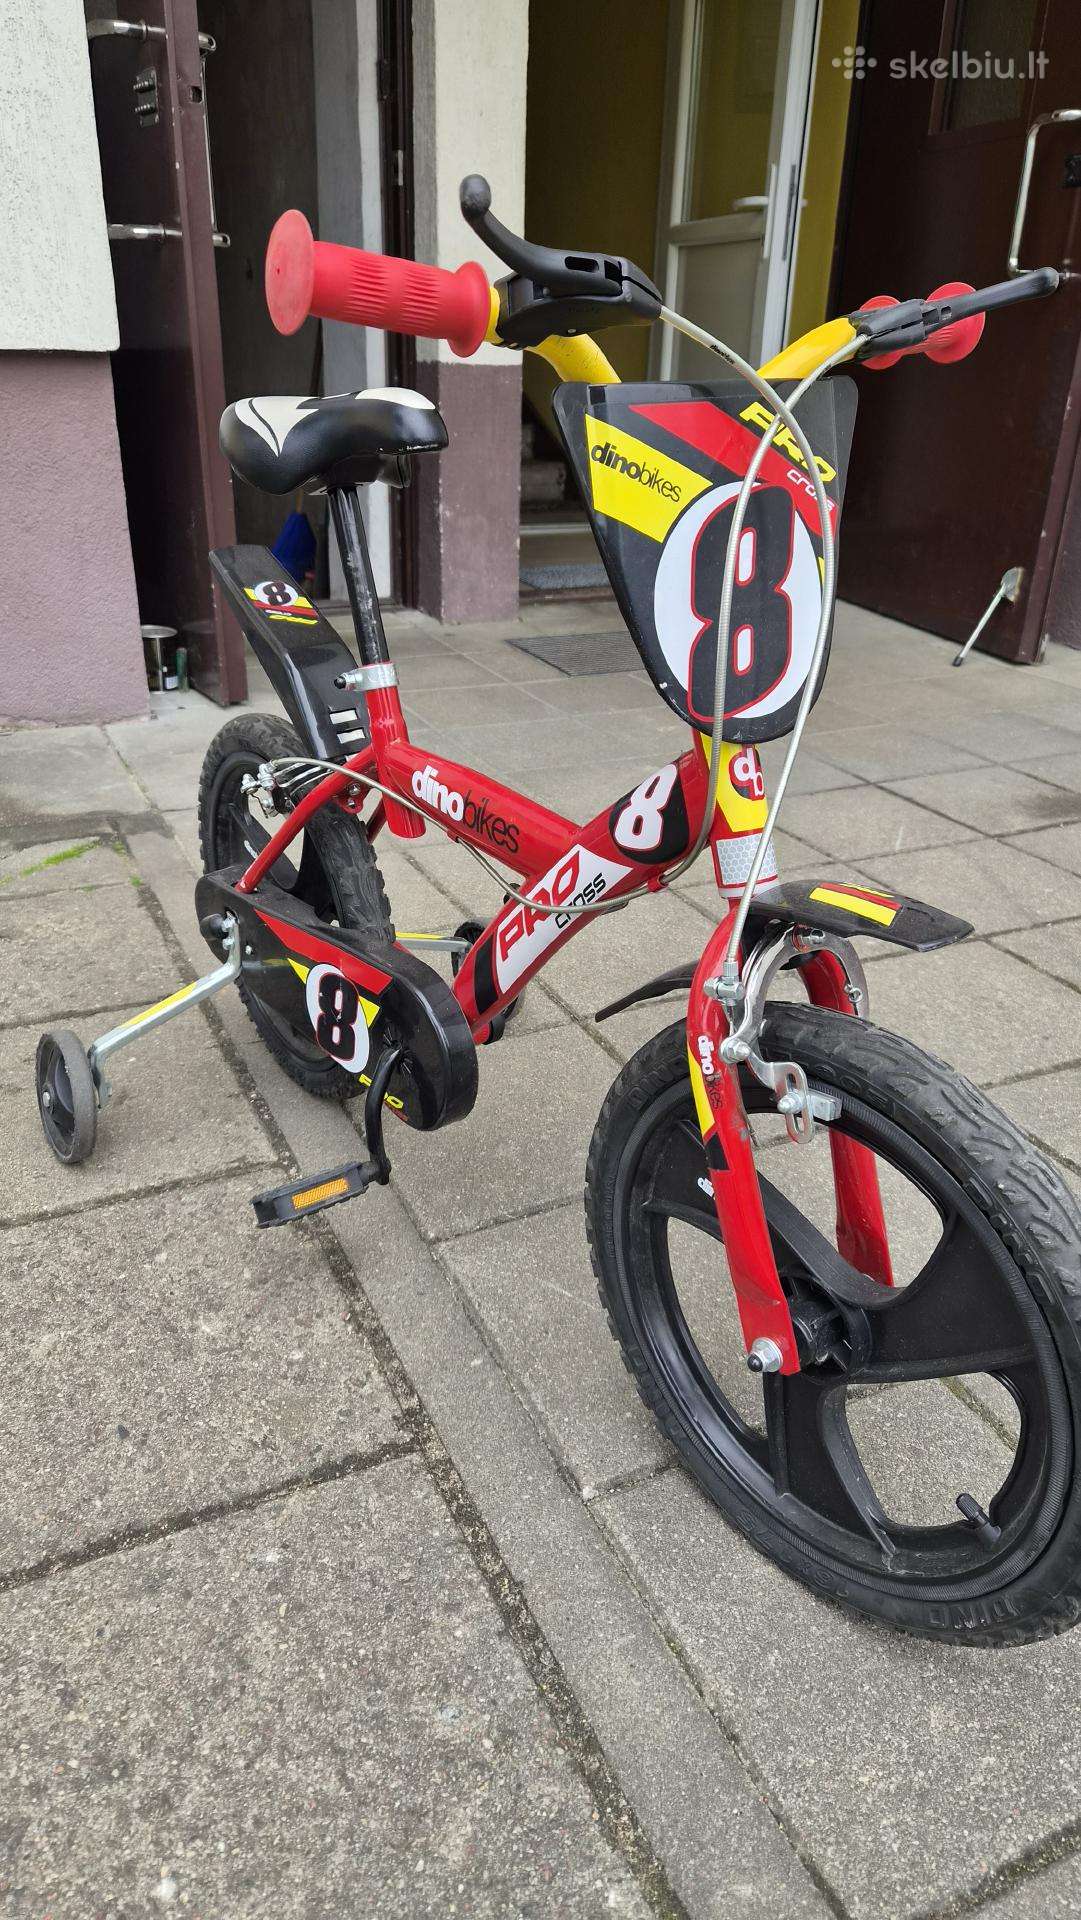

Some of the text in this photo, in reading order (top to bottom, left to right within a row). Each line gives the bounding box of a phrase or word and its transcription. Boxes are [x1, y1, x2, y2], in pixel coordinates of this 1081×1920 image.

[591, 442, 682, 502] dinobikes
[262, 581, 292, 606] 8
[687, 484, 796, 723] 8
[411, 764, 520, 854] dinobikes
[614, 763, 678, 851] 8
[499, 850, 581, 962] PRO
[316, 971, 360, 1062] 8
